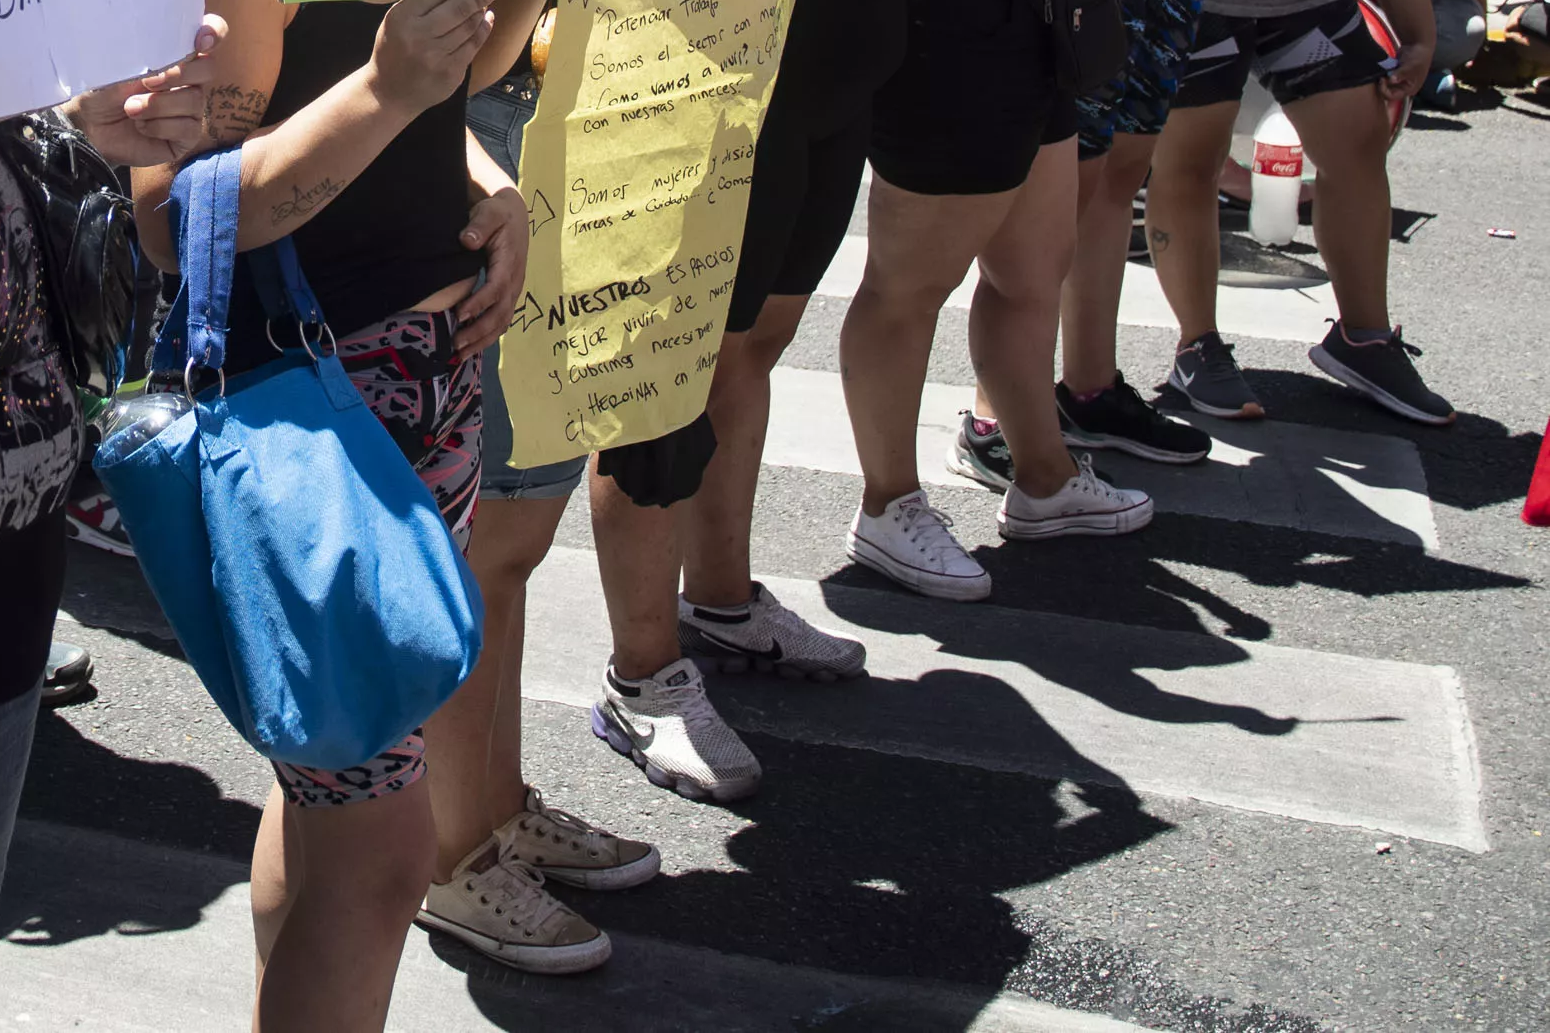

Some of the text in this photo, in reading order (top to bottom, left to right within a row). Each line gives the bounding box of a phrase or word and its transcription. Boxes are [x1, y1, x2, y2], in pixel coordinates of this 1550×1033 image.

[589, 52, 644, 80] Somos
[657, 44, 670, 61] el
[733, 17, 752, 35] con
[701, 66, 712, 79] a
[621, 99, 676, 124] nuestras
[569, 177, 630, 215] Somos
[710, 155, 718, 175] y
[567, 215, 615, 237] Tareas
[547, 274, 651, 331] NUESTROS
[674, 296, 698, 314] de
[674, 372, 689, 386] en
